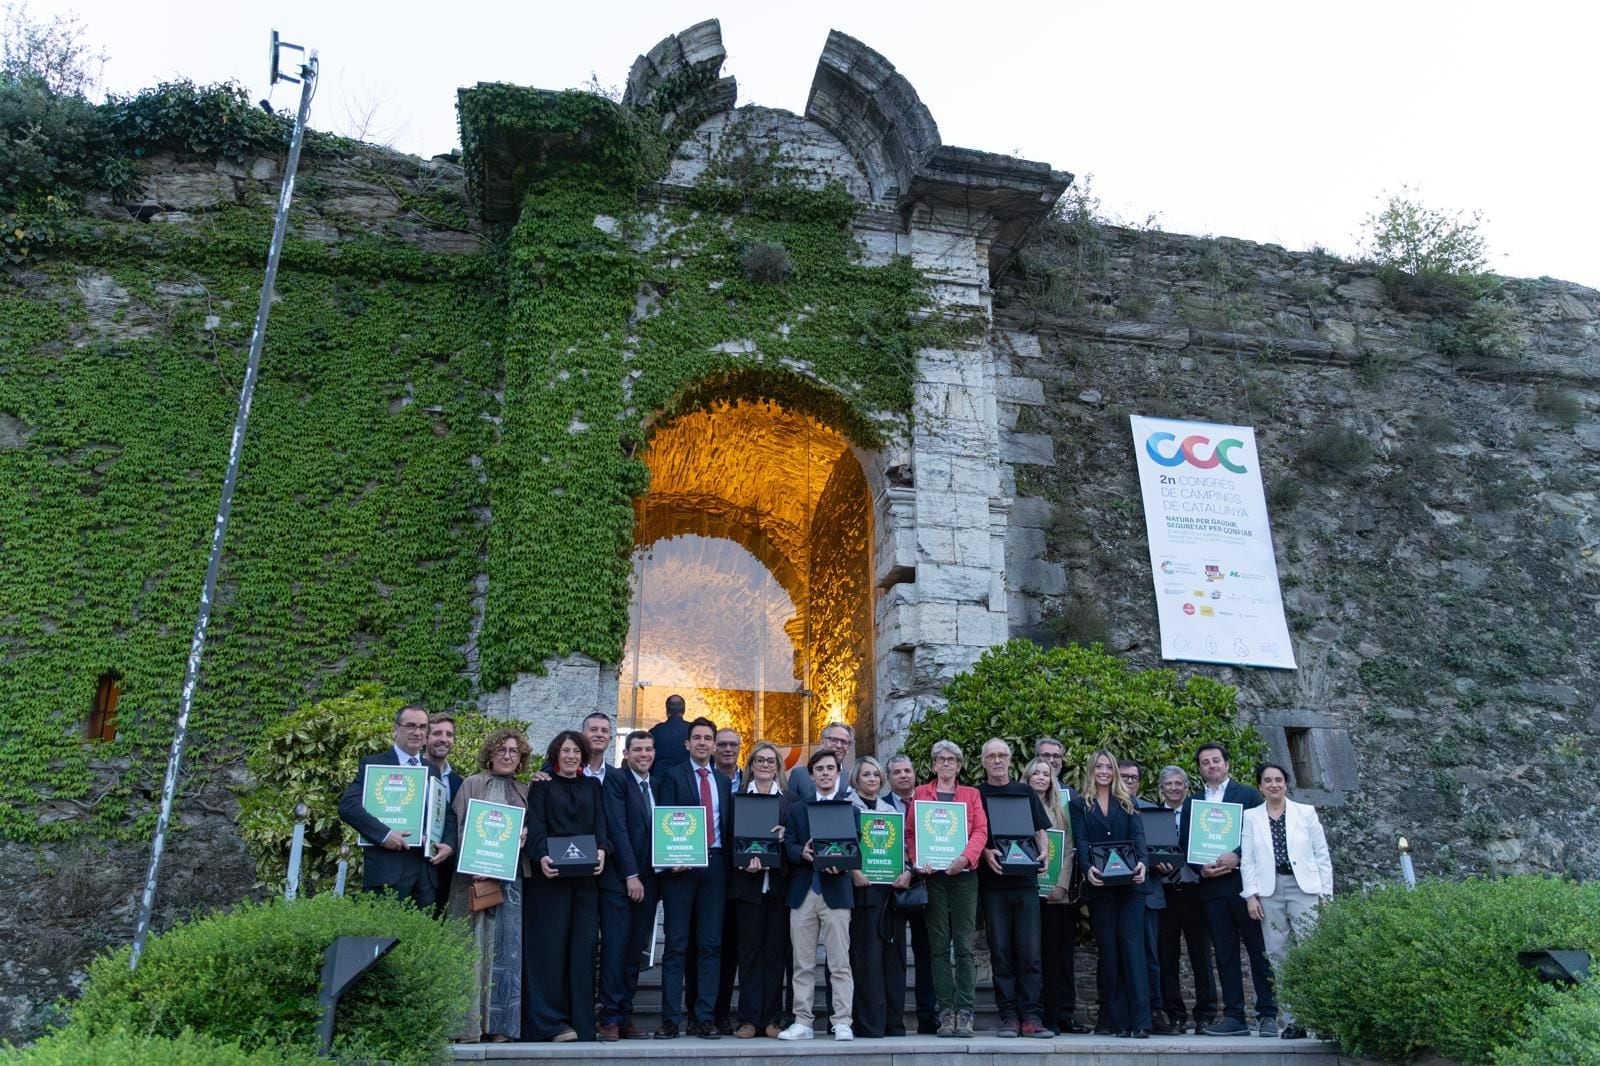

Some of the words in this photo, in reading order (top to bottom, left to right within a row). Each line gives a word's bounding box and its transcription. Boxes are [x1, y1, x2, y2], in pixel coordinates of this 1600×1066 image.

[1160, 474, 1176, 485] 2n
[1161, 487, 1177, 498] DE
[1180, 489, 1242, 504] CAMPINGS
[1163, 500, 1179, 511] DE
[1182, 501, 1248, 518] CATALUNYA
[1166, 516, 1194, 524] NATURA
[1166, 522, 1207, 531] SEGURETAT
[476, 848, 504, 859] WINNER
